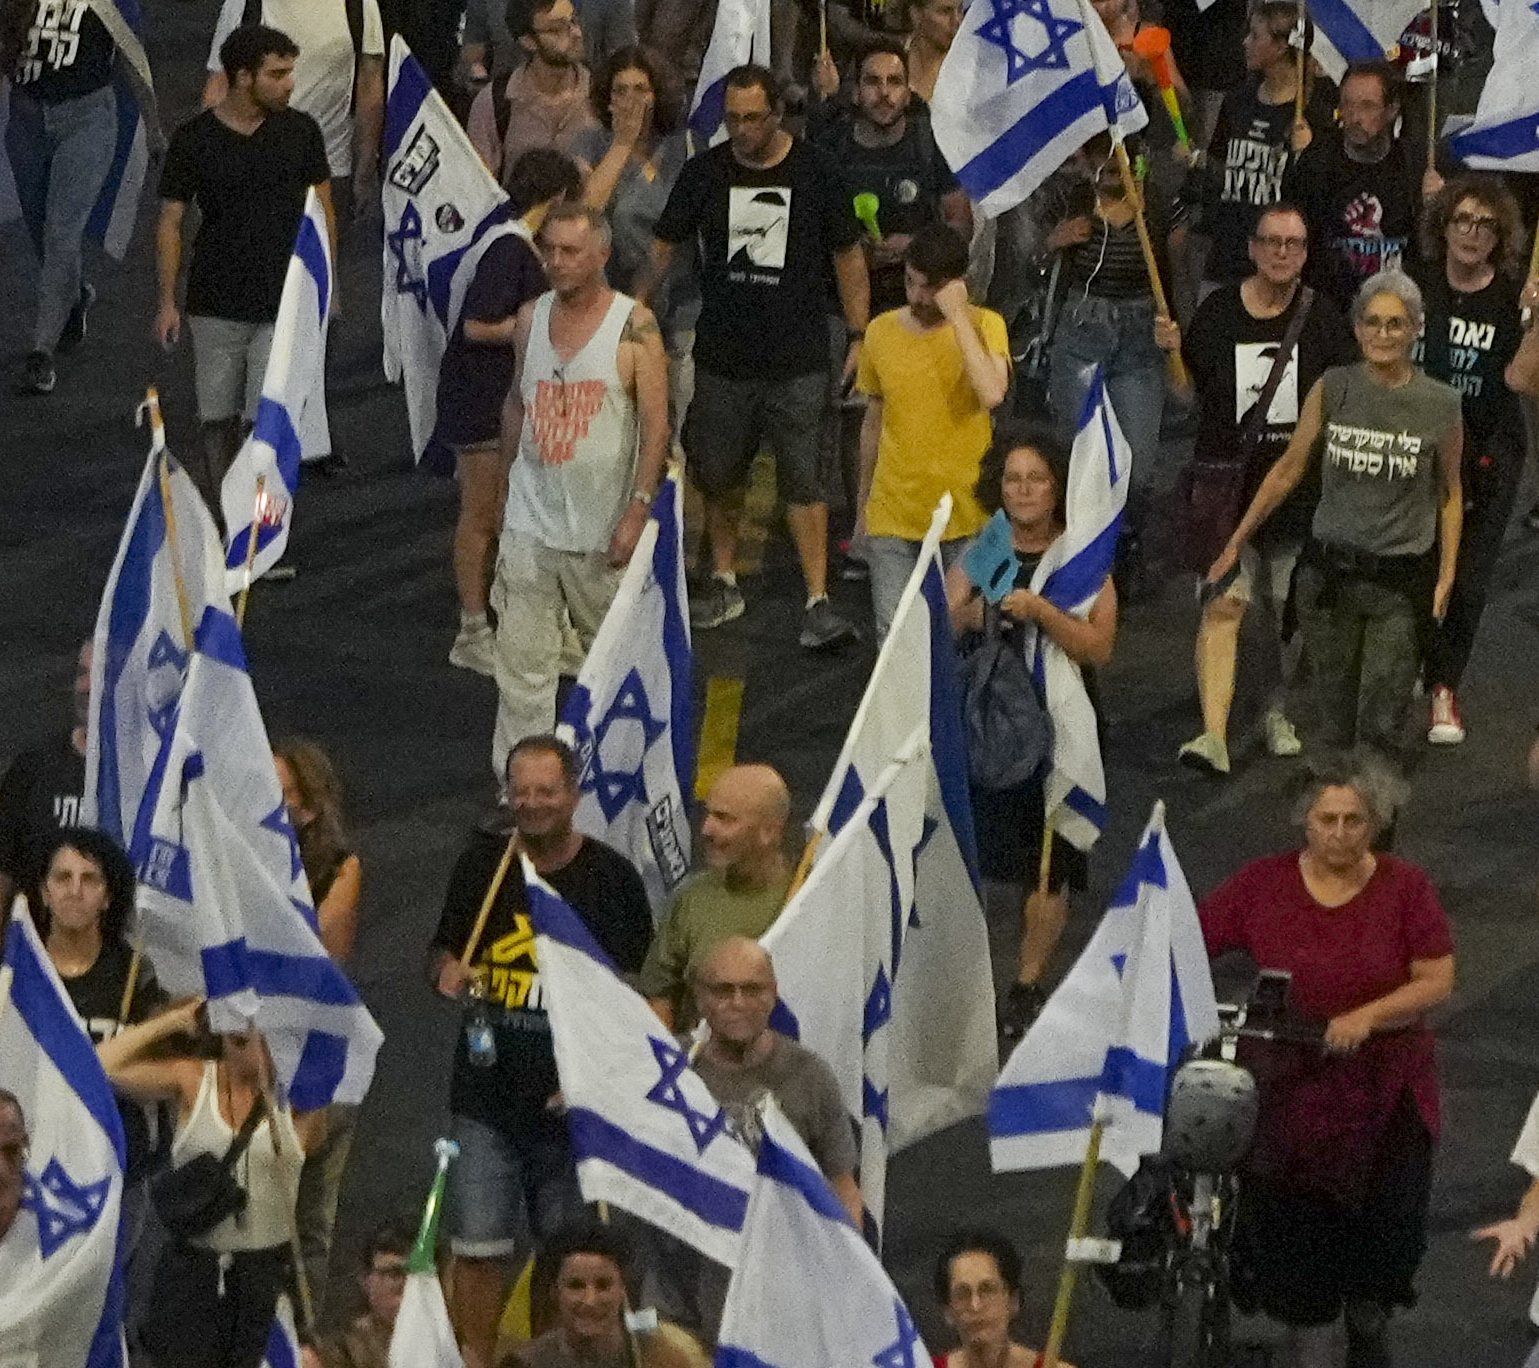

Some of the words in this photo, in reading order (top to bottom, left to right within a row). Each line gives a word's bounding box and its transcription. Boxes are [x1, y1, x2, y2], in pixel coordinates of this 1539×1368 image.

[1448, 316, 1497, 351] נאמ
[1398, 430, 1422, 455] בלי
[1388, 453, 1418, 482] אין
